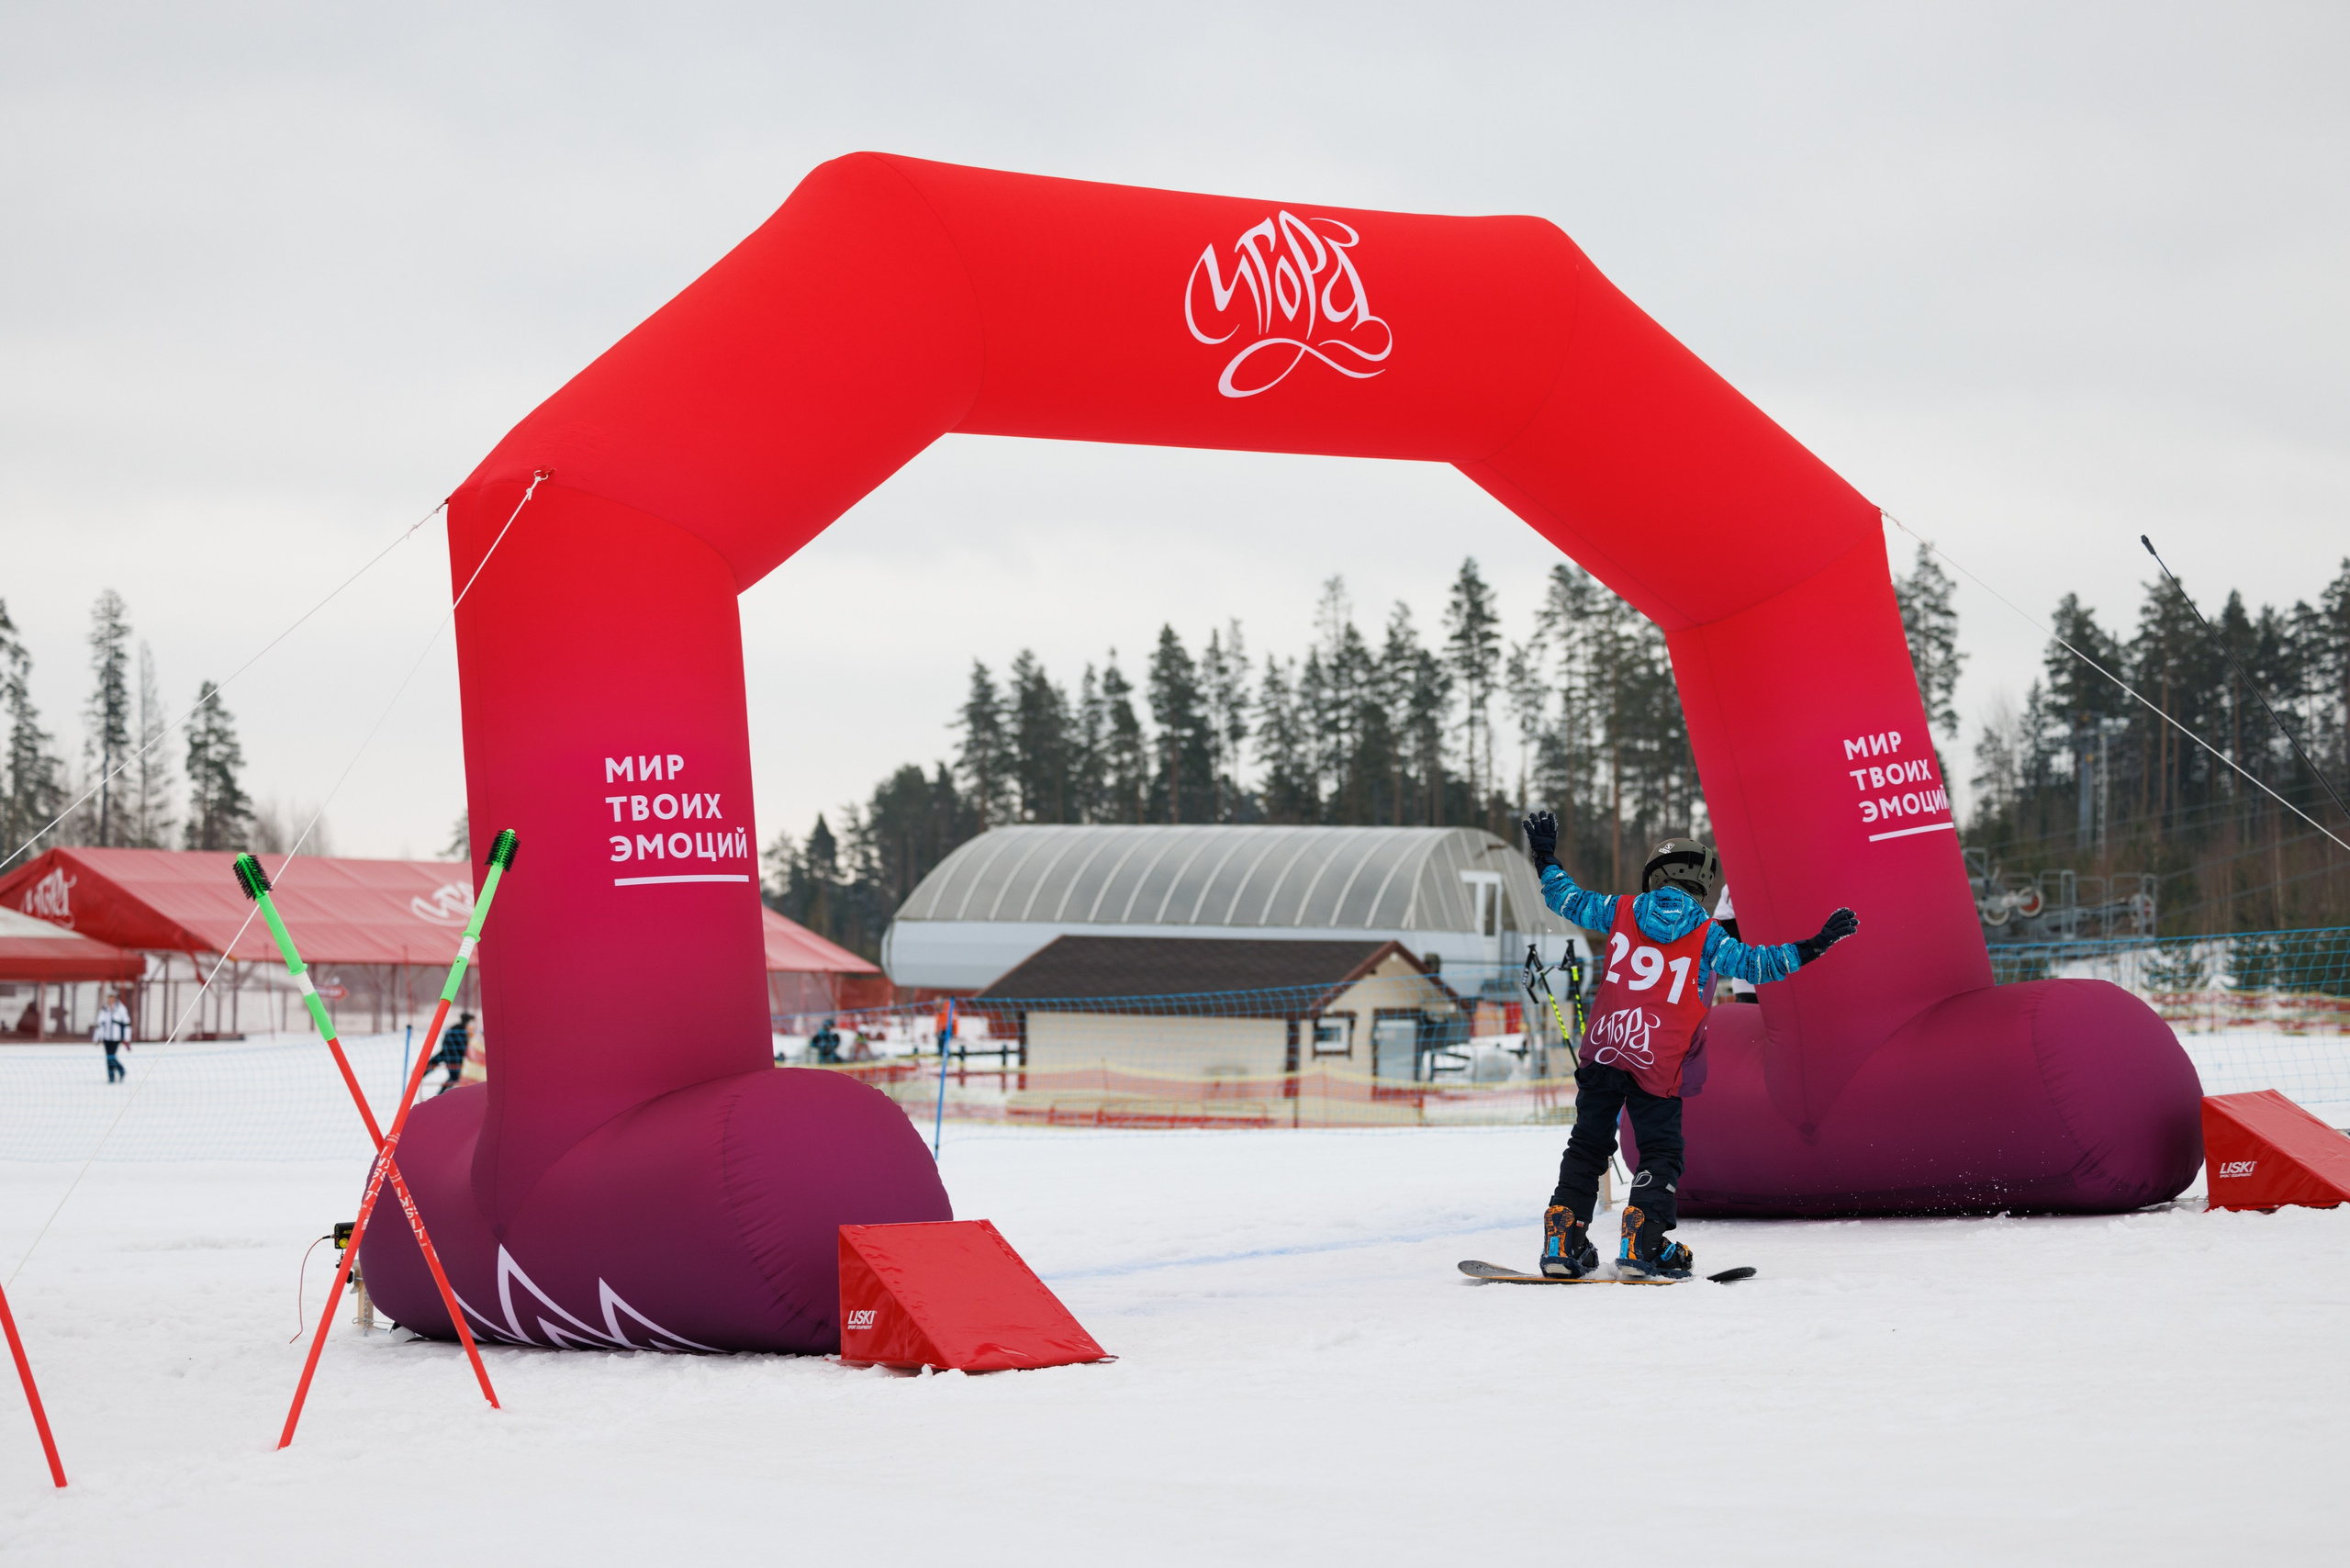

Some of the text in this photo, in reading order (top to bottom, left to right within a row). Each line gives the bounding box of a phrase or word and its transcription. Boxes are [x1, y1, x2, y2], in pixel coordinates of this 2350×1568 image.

[1843, 731, 1902, 760] МИР
[605, 754, 684, 783] МИР
[1849, 758, 1932, 791] ТВОИХ
[605, 793, 723, 823] ТВОИХ
[609, 826, 748, 862] ЭМОЦИЙ
[1606, 931, 1692, 1005] 291
[2219, 1161, 2254, 1174] LISKI
[847, 1310, 875, 1324] LISKI
